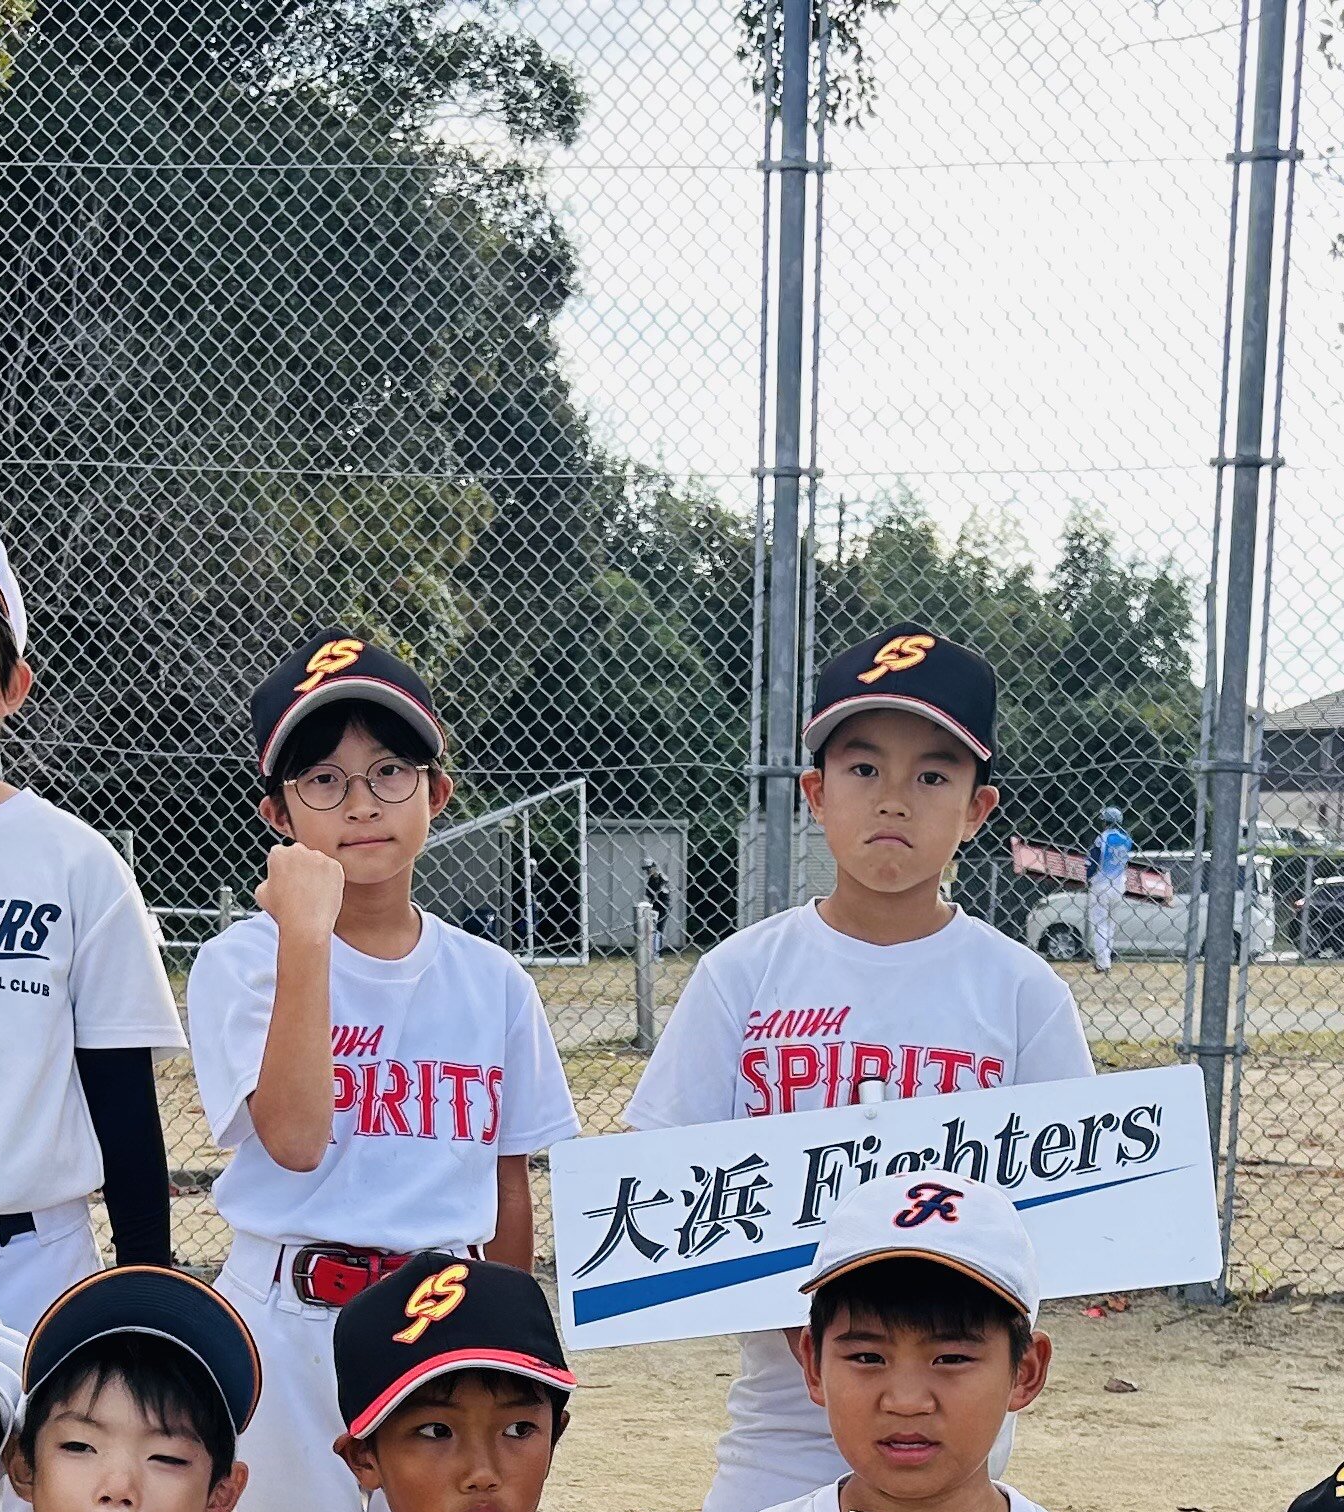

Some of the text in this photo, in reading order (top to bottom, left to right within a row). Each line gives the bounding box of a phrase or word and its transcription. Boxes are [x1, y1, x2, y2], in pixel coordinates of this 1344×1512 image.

[10, 978, 51, 997] CLUB
[743, 1005, 852, 1041] SANWA
[329, 1059, 504, 1146] PIRITS
[571, 1152, 774, 1279] 大浜
